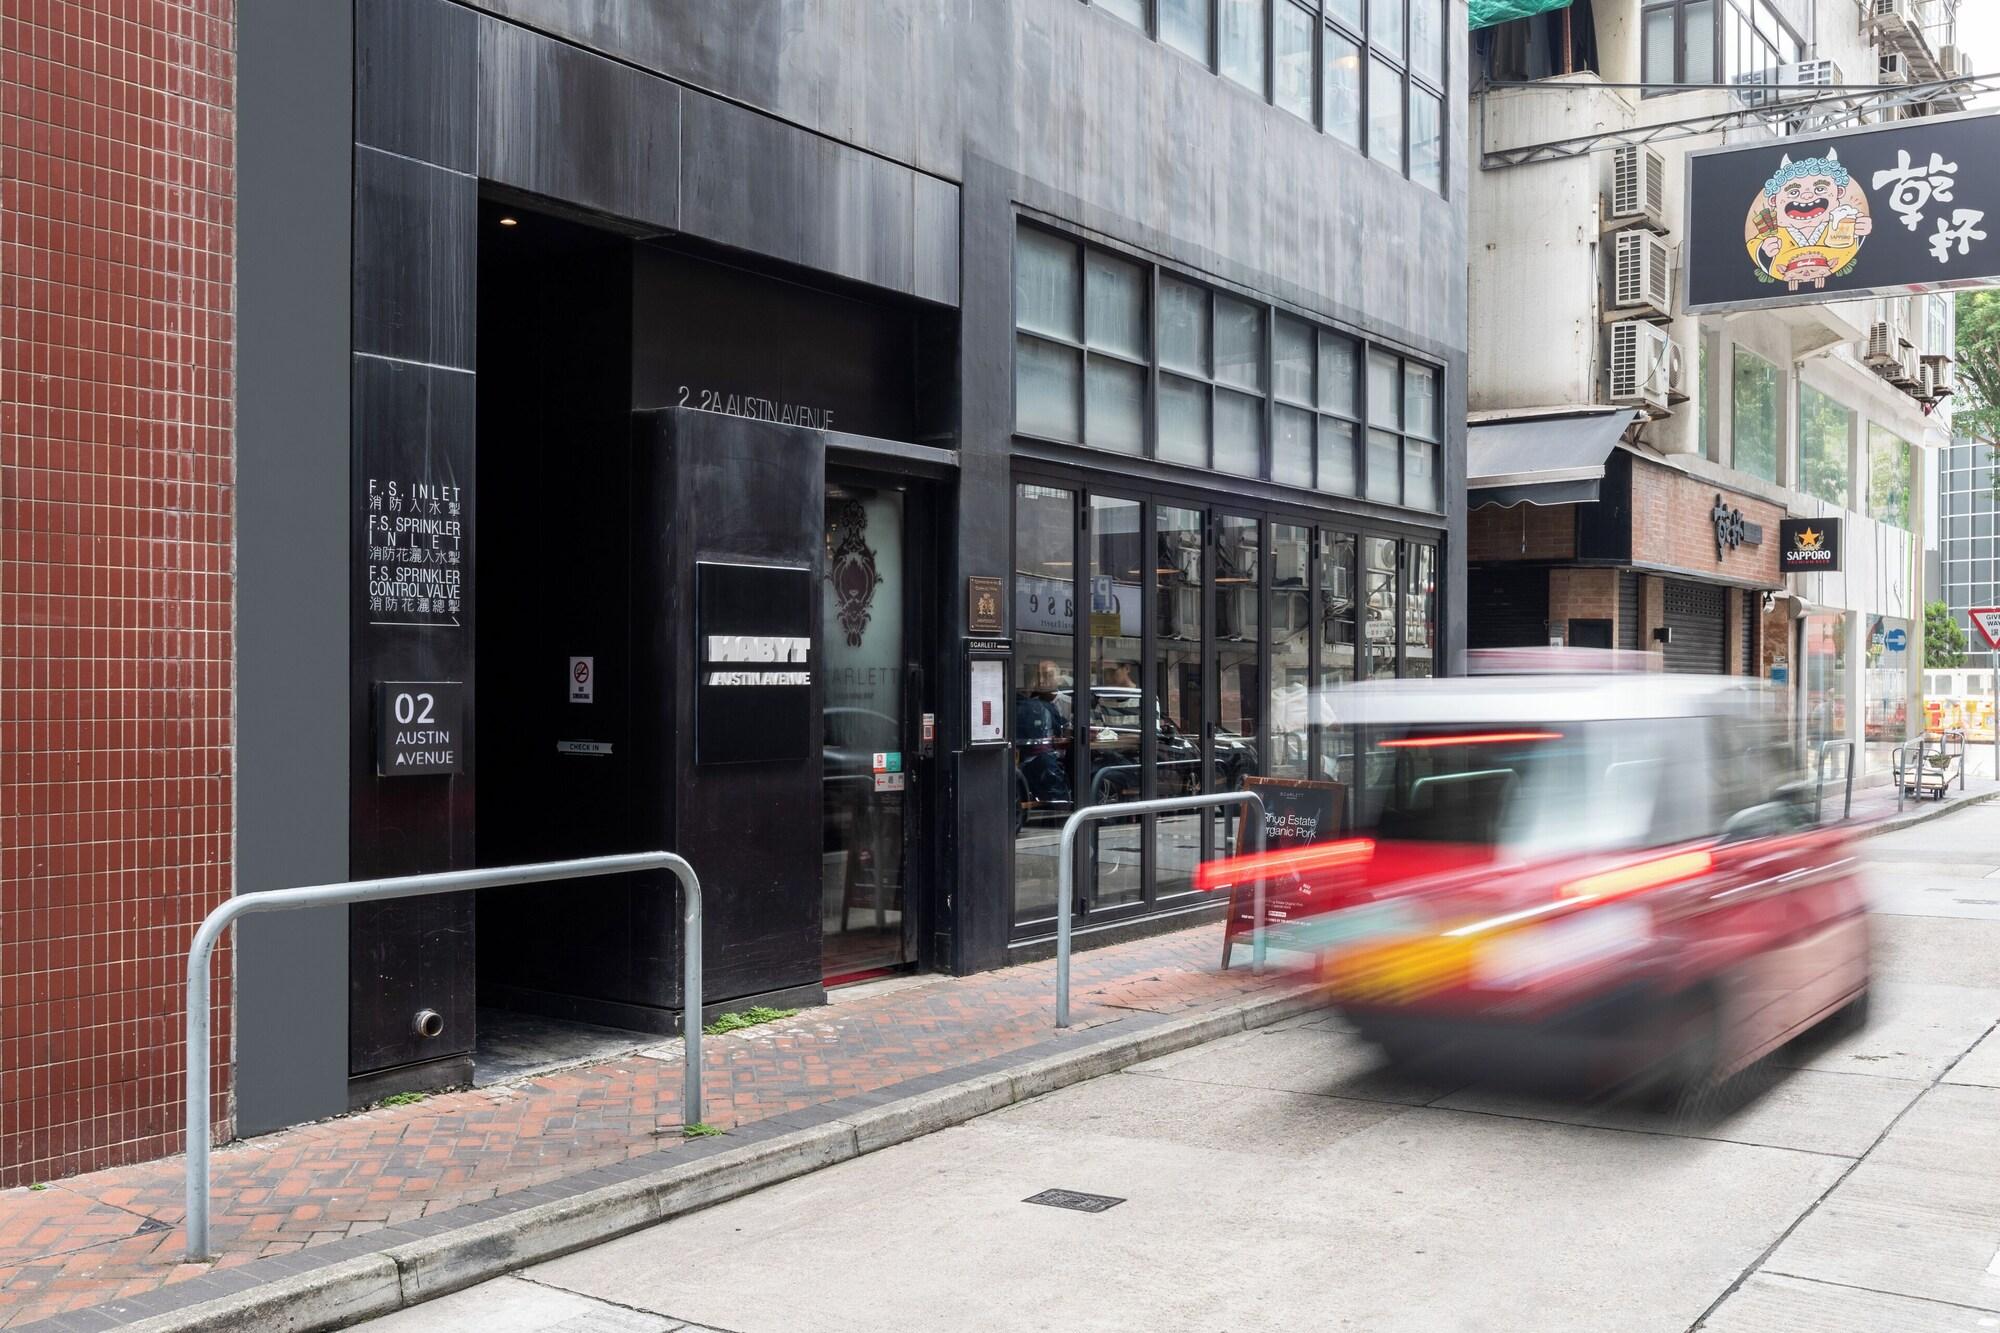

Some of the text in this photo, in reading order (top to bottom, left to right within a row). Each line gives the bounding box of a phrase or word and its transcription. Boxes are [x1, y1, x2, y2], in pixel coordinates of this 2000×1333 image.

[701, 390, 723, 414] 2A
[726, 394, 777, 422] AUSTIN
[369, 479, 460, 501] F.S. INLET
[369, 515, 460, 536] F.S. SPRINKLER
[369, 531, 460, 551] INLET
[1786, 550, 1831, 561] SAPPORO
[369, 565, 460, 584] F.S. SPRINKLER
[369, 580, 460, 599] CONTROL VALVE
[709, 636, 811, 663] HABYT
[970, 641, 997, 649] SCARLETT
[709, 672, 811, 686] AUSTIN AVENUE
[395, 693, 435, 723] 02
[395, 731, 450, 745] AUSTIN
[569, 743, 591, 751] CHECK
[395, 751, 454, 766] AVENUE
[1288, 814, 1316, 827] Estate
[1265, 826, 1317, 839] rganic Pork
